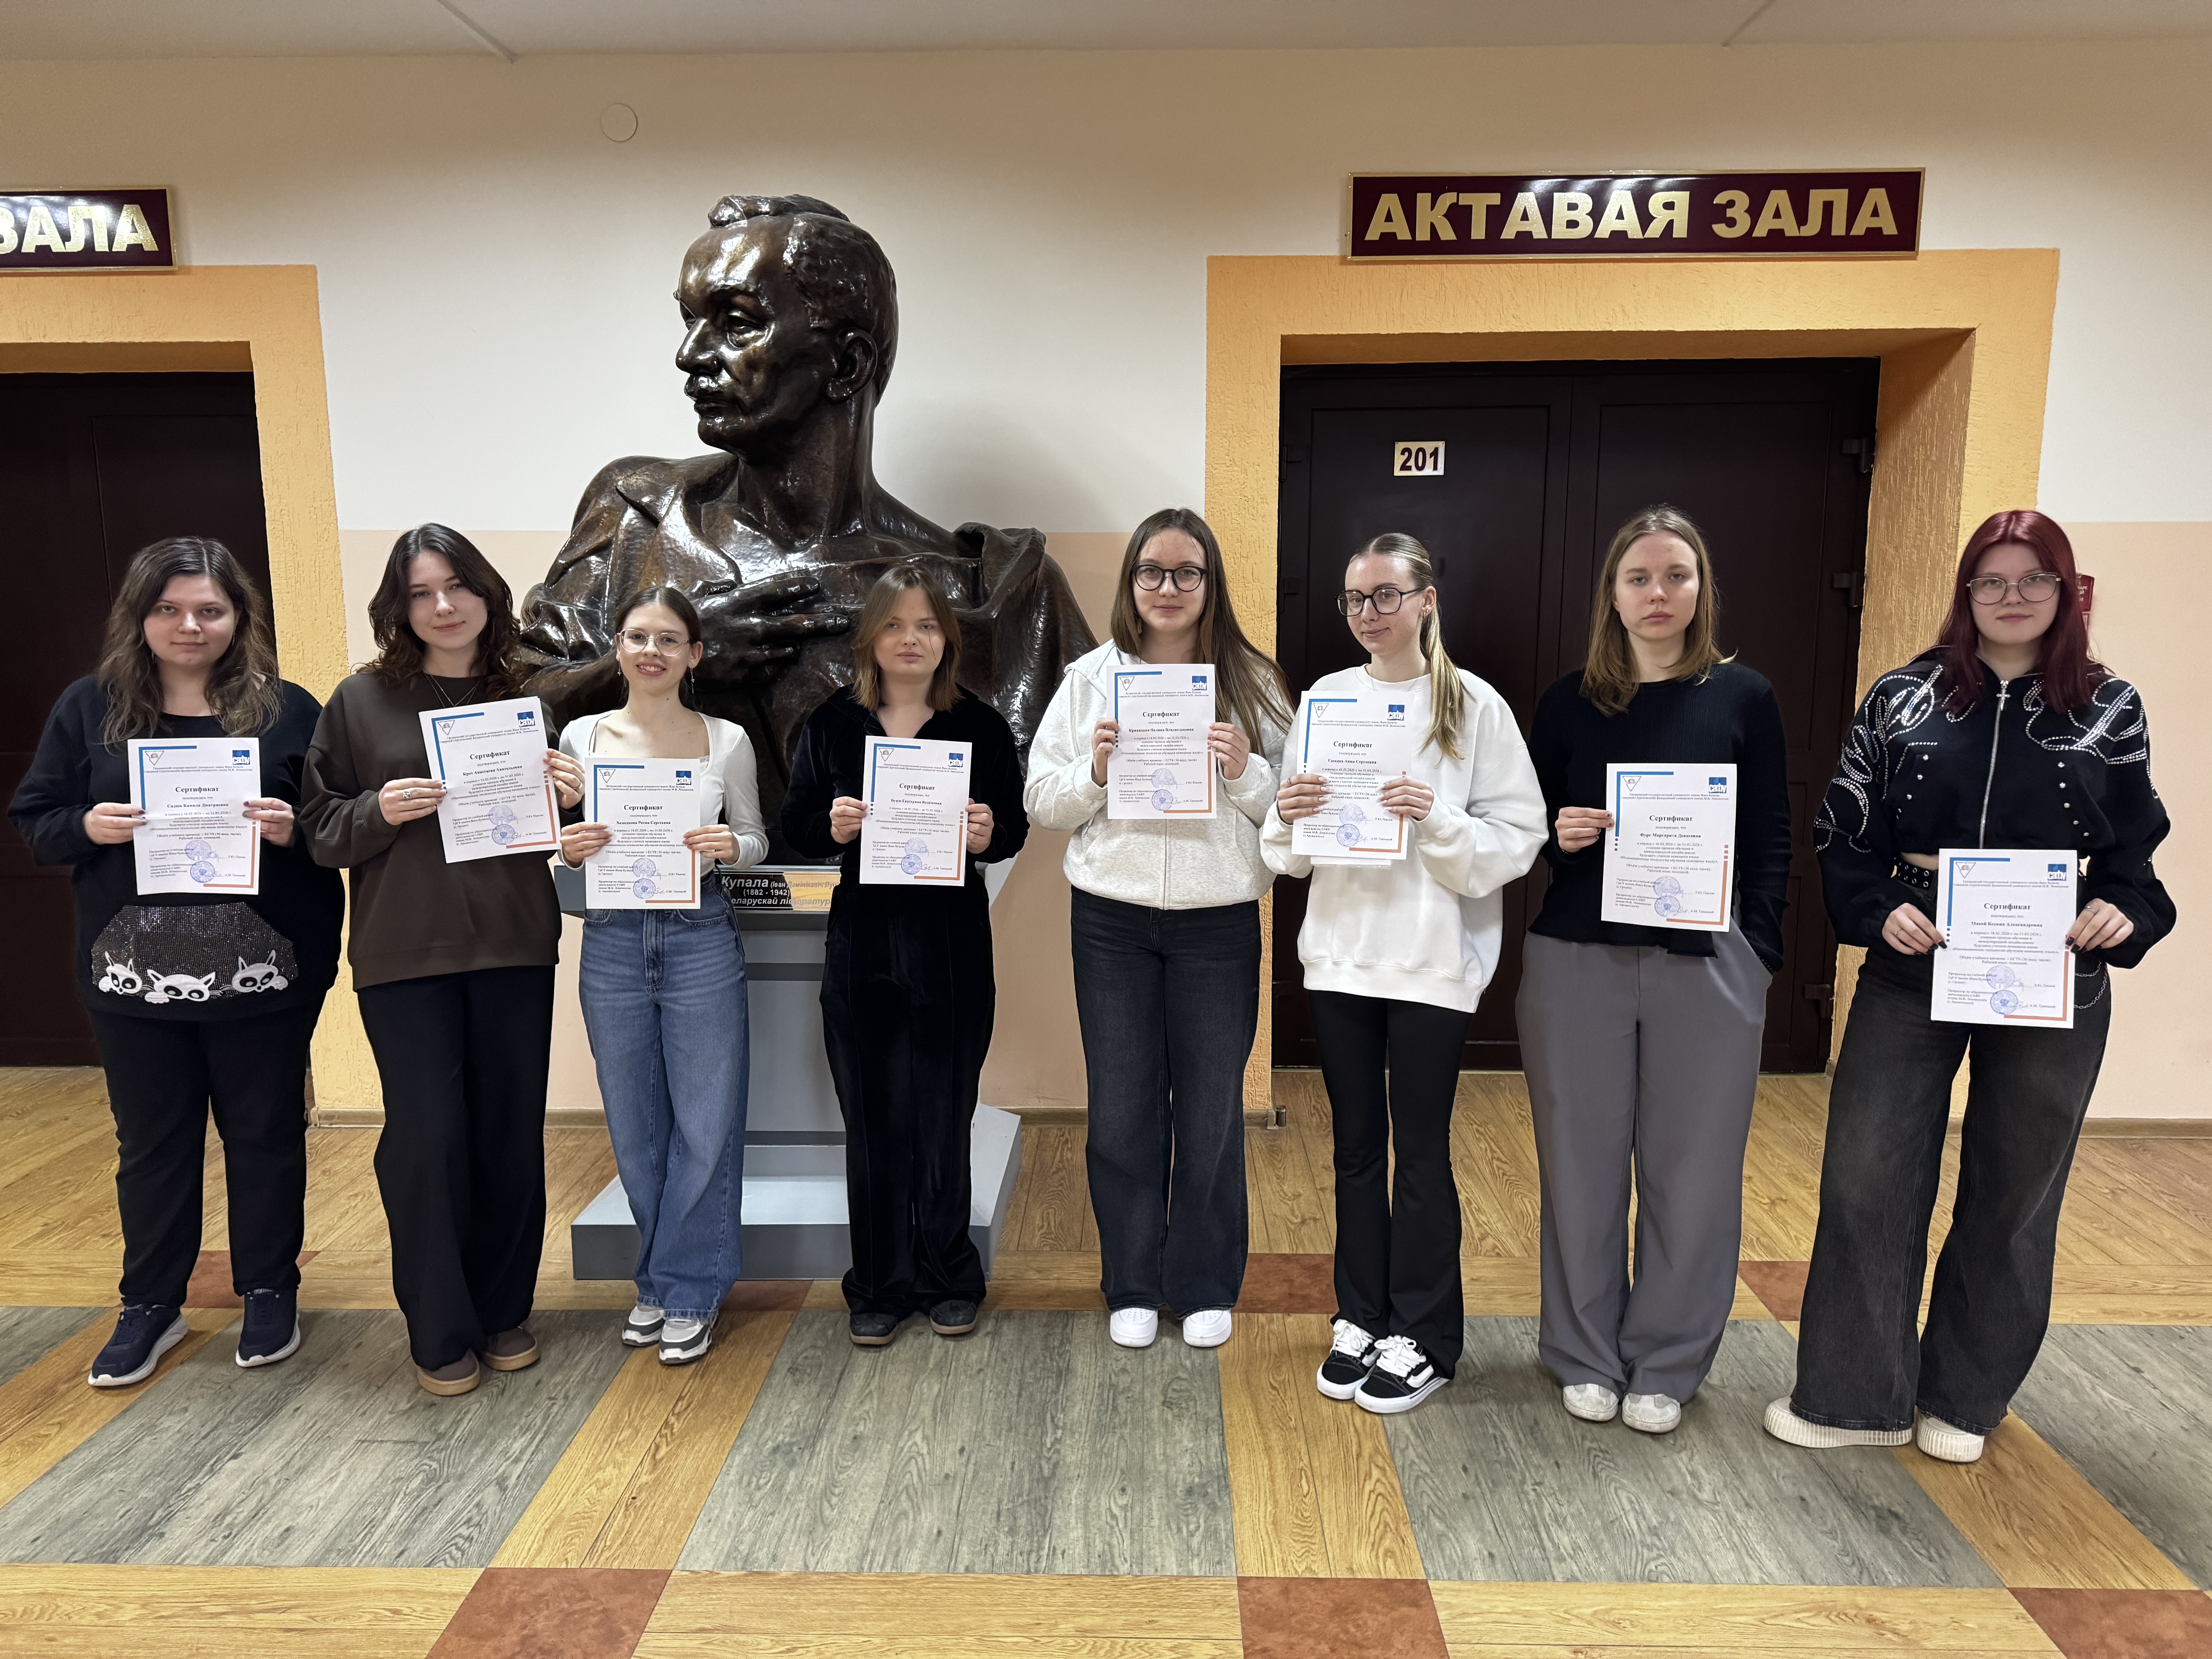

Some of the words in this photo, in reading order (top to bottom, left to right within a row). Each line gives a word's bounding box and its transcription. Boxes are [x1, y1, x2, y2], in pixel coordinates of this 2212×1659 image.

[1364, 191, 1690, 240] АКТАВАЯ
[1712, 188, 1898, 238] ЗАЛА
[1399, 447, 1439, 471] 201
[470, 751, 510, 760] Сертификат
[721, 876, 769, 890] Купала
[743, 889, 763, 897] (1882
[770, 889, 790, 897] 1942)
[731, 897, 778, 906] еларускай
